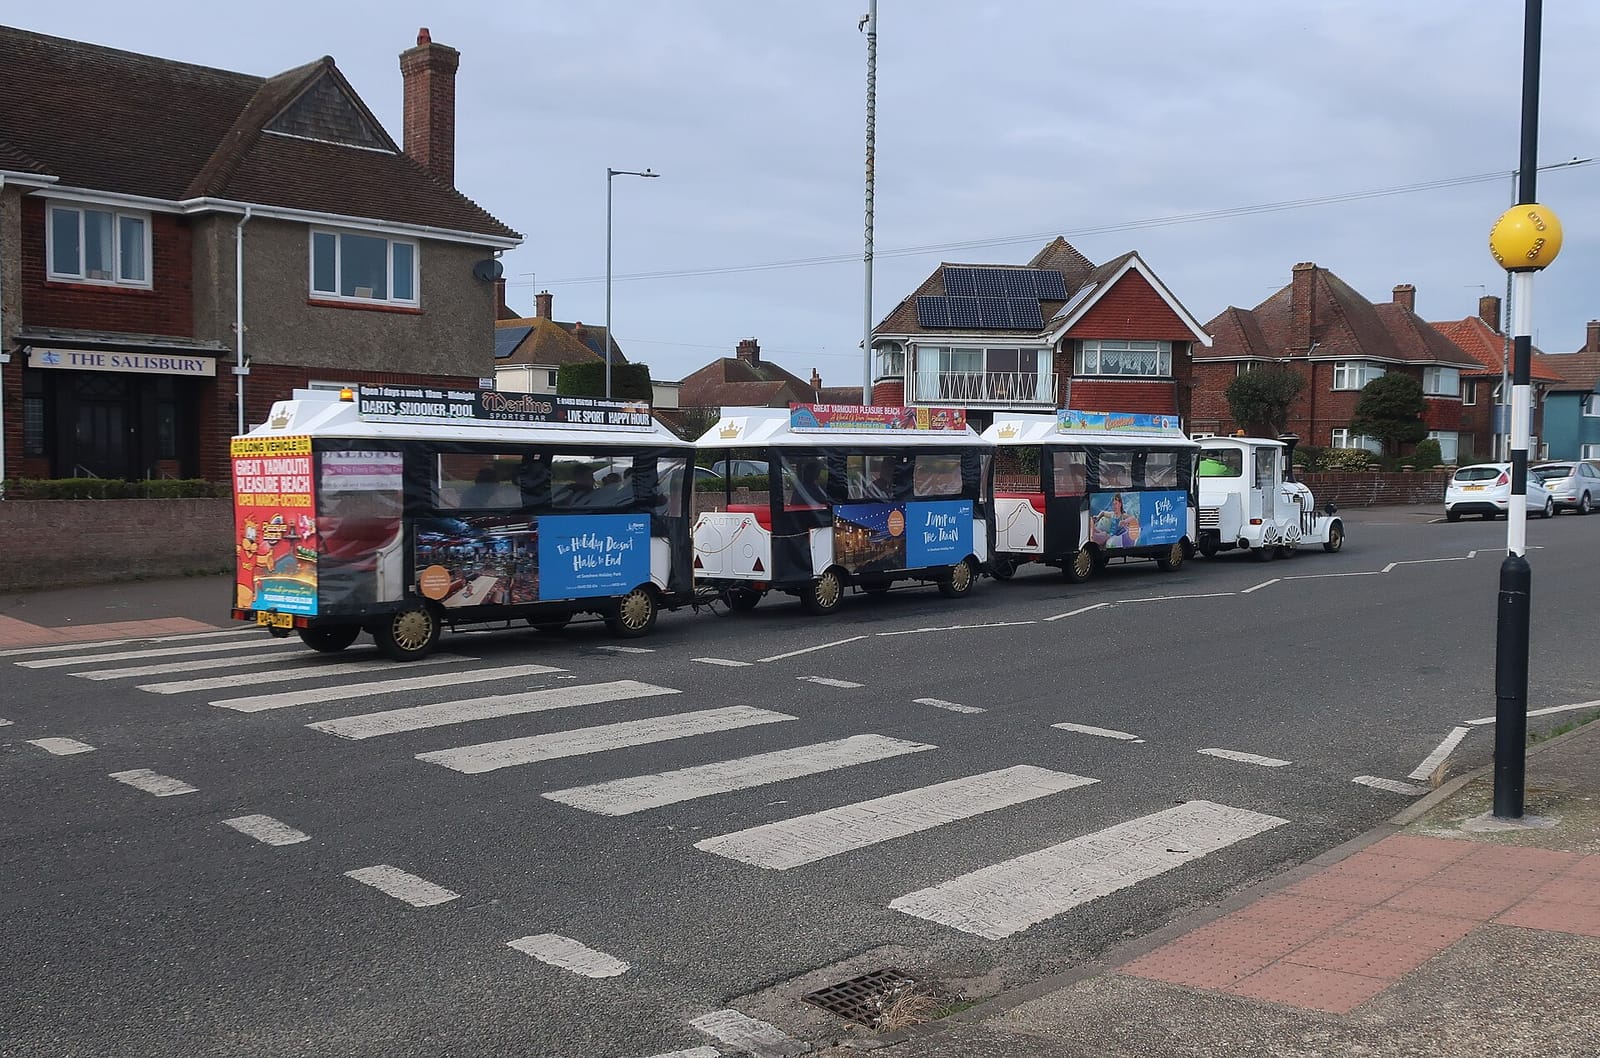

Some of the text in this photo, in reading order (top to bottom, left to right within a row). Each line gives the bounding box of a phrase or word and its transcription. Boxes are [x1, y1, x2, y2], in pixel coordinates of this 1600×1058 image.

[68, 352, 207, 372] THE SALISBURY
[361, 386, 379, 397] Open
[384, 387, 400, 397] days
[406, 389, 423, 398] week
[448, 391, 476, 401] Midnight
[361, 400, 475, 417] DARTS SNOOKER POOL
[482, 391, 553, 414] Merlins
[813, 404, 901, 416] GREAT YARMOUTH PLEASURE BEACH
[489, 412, 546, 422] SPORTS BAR
[567, 409, 650, 426] LIVE SPORT HAPPY HOUR
[244, 442, 264, 453] LONG
[265, 441, 297, 452] VEHICLE
[236, 458, 309, 476] GREAT YARMOUTH
[237, 476, 280, 493] PLEASURE
[280, 475, 311, 493] BEACH
[238, 493, 254, 507] OPEN
[557, 543, 570, 555] The
[605, 552, 622, 567] End
